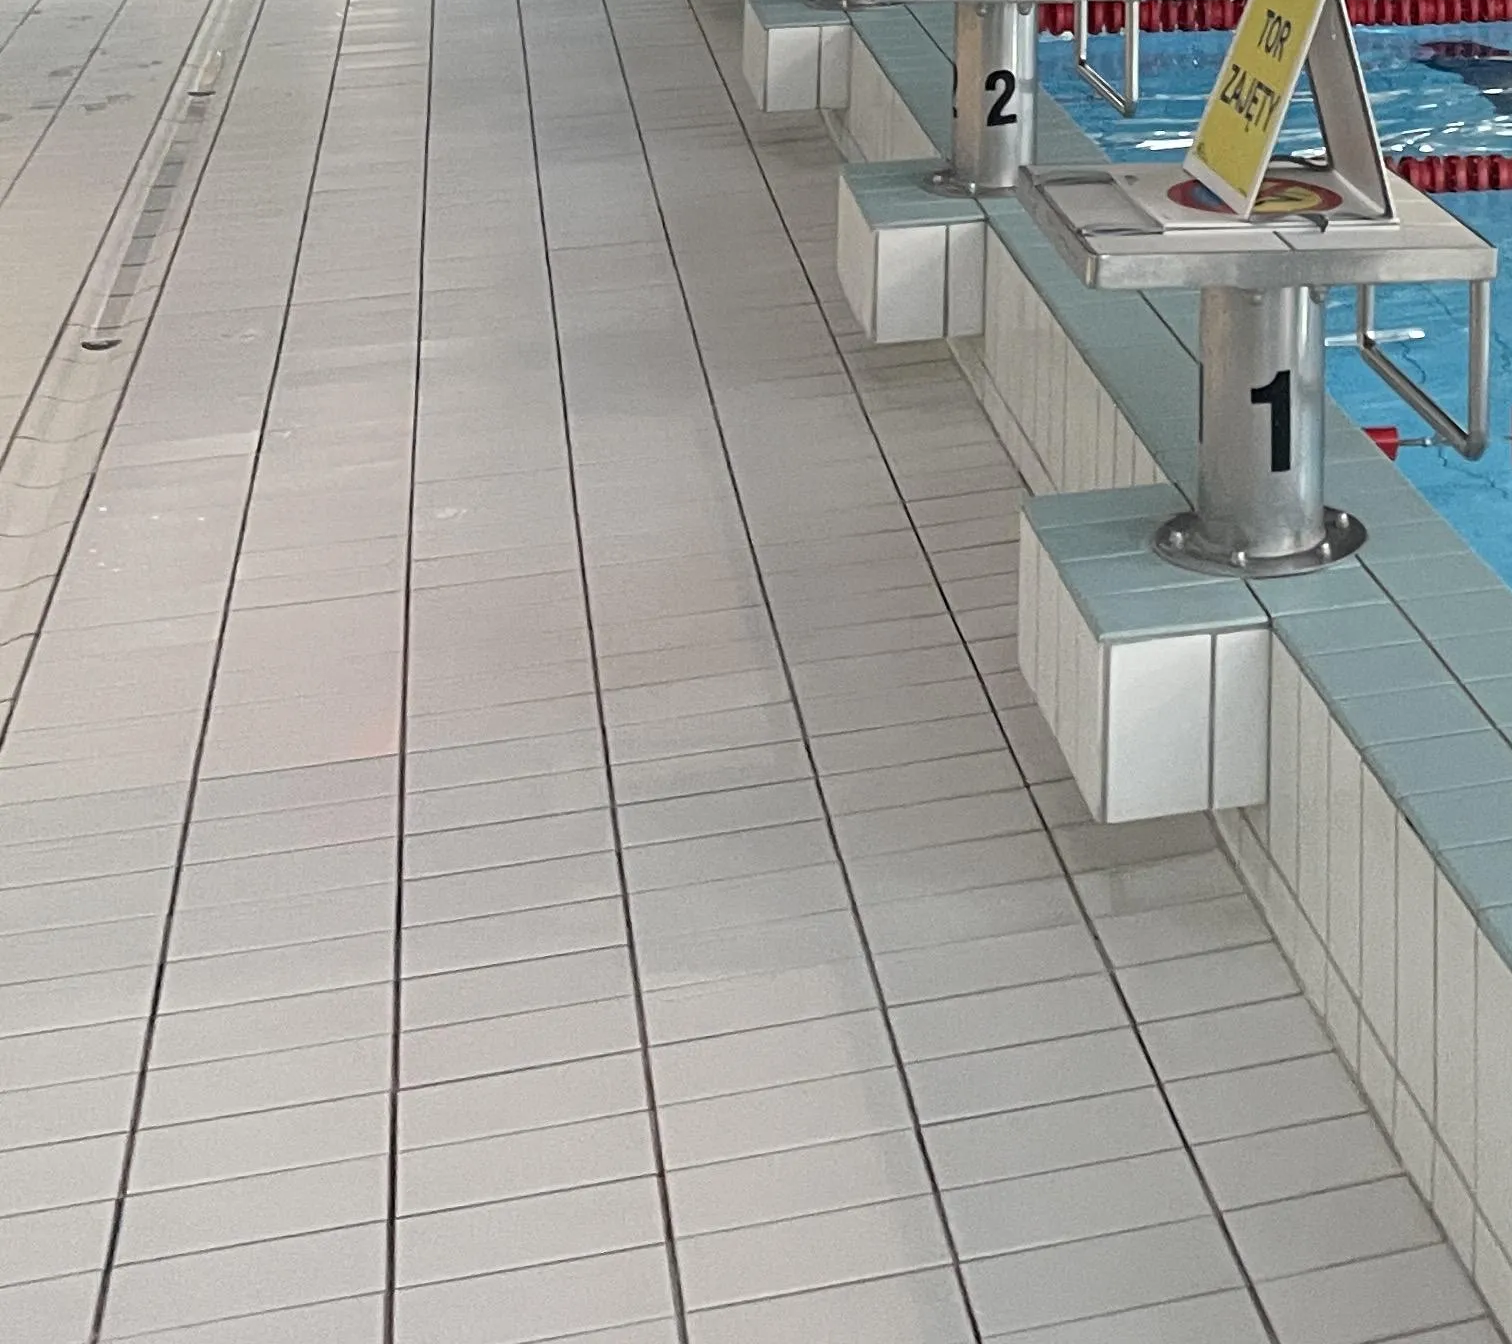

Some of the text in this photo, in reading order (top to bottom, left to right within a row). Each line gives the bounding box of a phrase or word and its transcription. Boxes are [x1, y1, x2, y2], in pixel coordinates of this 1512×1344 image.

[1257, 8, 1292, 62] TOR
[985, 69, 1018, 127] 2
[1220, 63, 1281, 133] ZAJĘTY
[1251, 370, 1291, 473] 1
